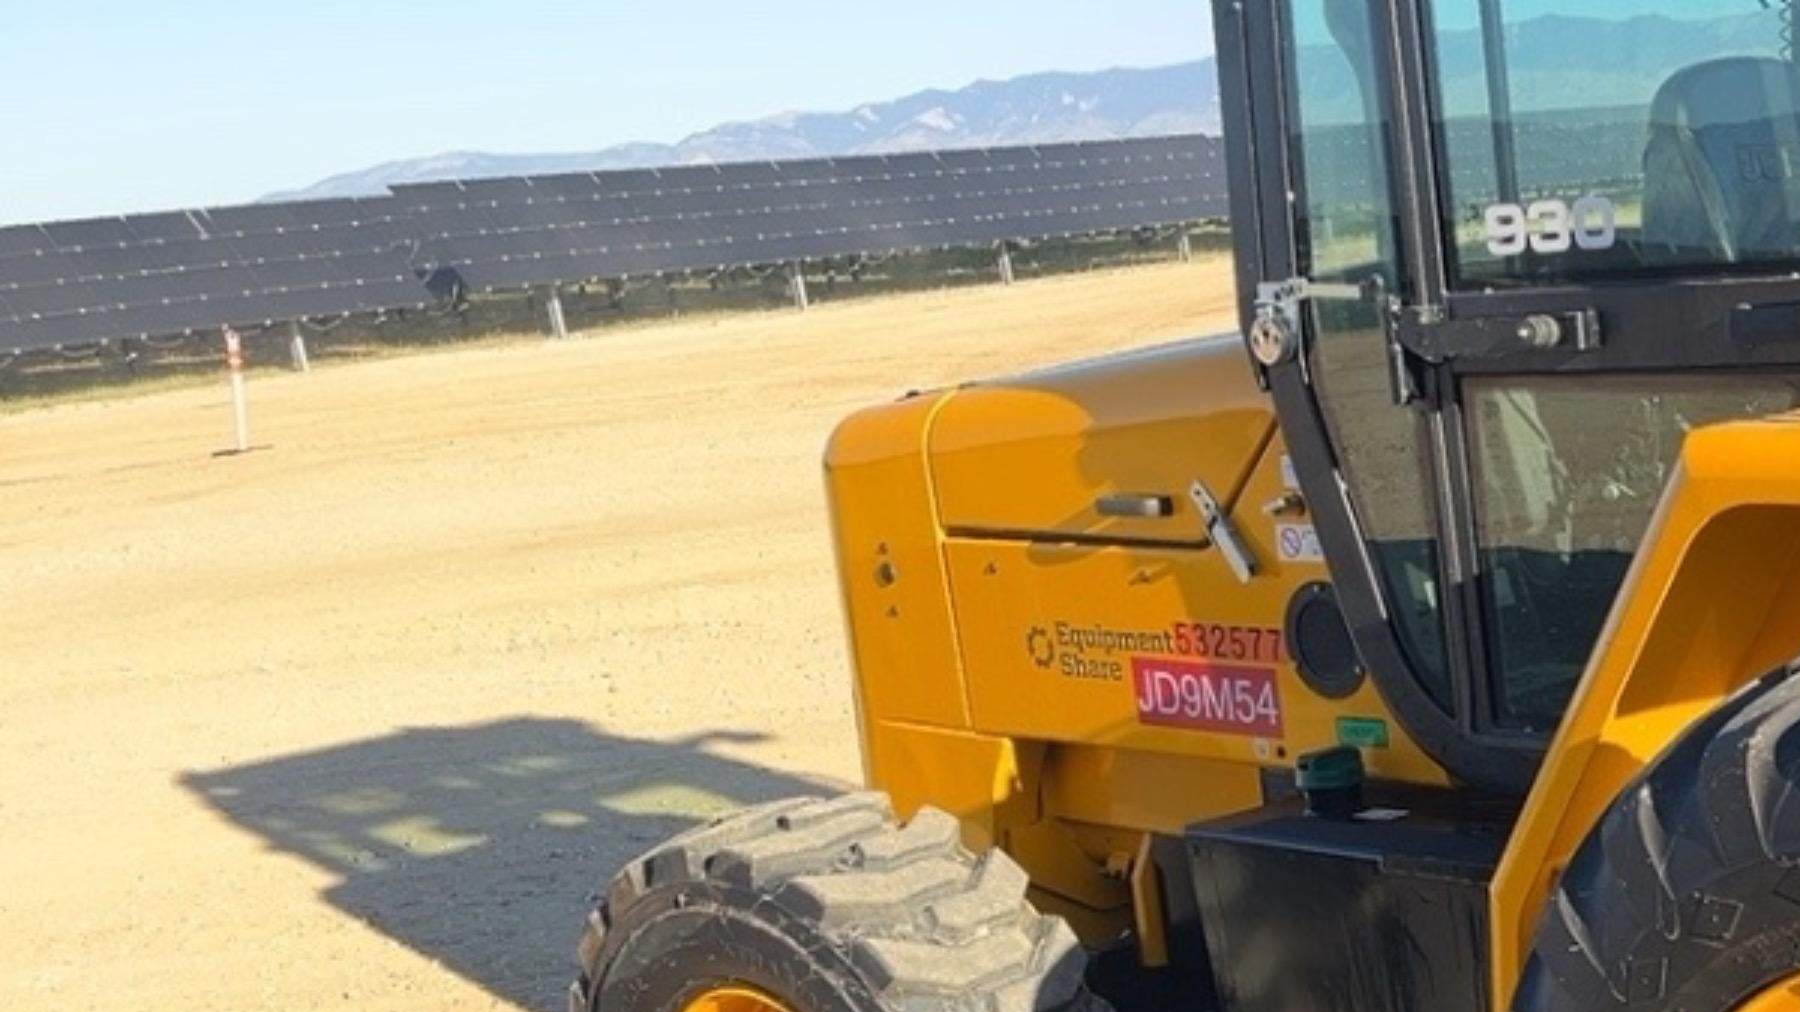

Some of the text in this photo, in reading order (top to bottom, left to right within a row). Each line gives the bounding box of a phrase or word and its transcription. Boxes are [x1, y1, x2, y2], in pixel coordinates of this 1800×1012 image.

[1484, 196, 1615, 256] 930
[1054, 621, 1173, 654] Equipment
[1173, 622, 1281, 662] 532577
[1059, 652, 1123, 682] Share
[1138, 669, 1278, 726] JD9M54
